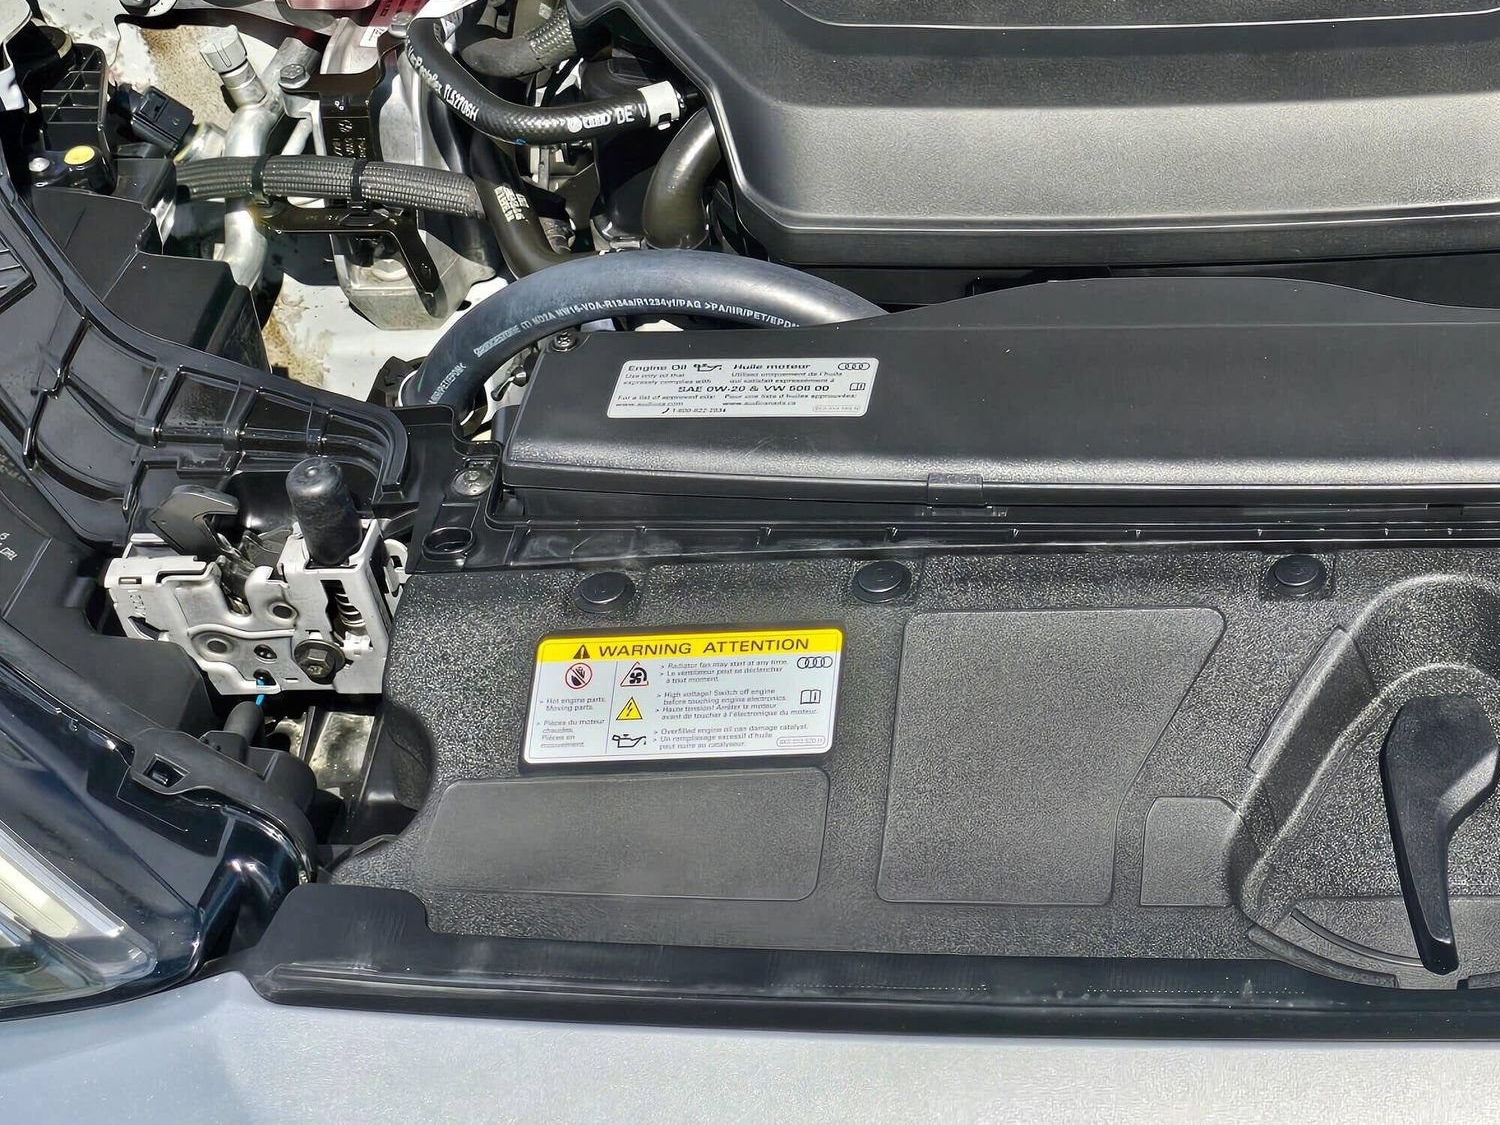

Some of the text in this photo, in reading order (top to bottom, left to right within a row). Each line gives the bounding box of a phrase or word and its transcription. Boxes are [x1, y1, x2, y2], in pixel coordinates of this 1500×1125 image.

[616, 107, 634, 125] DE
[599, 638, 809, 658] WARNING ATTENTION
